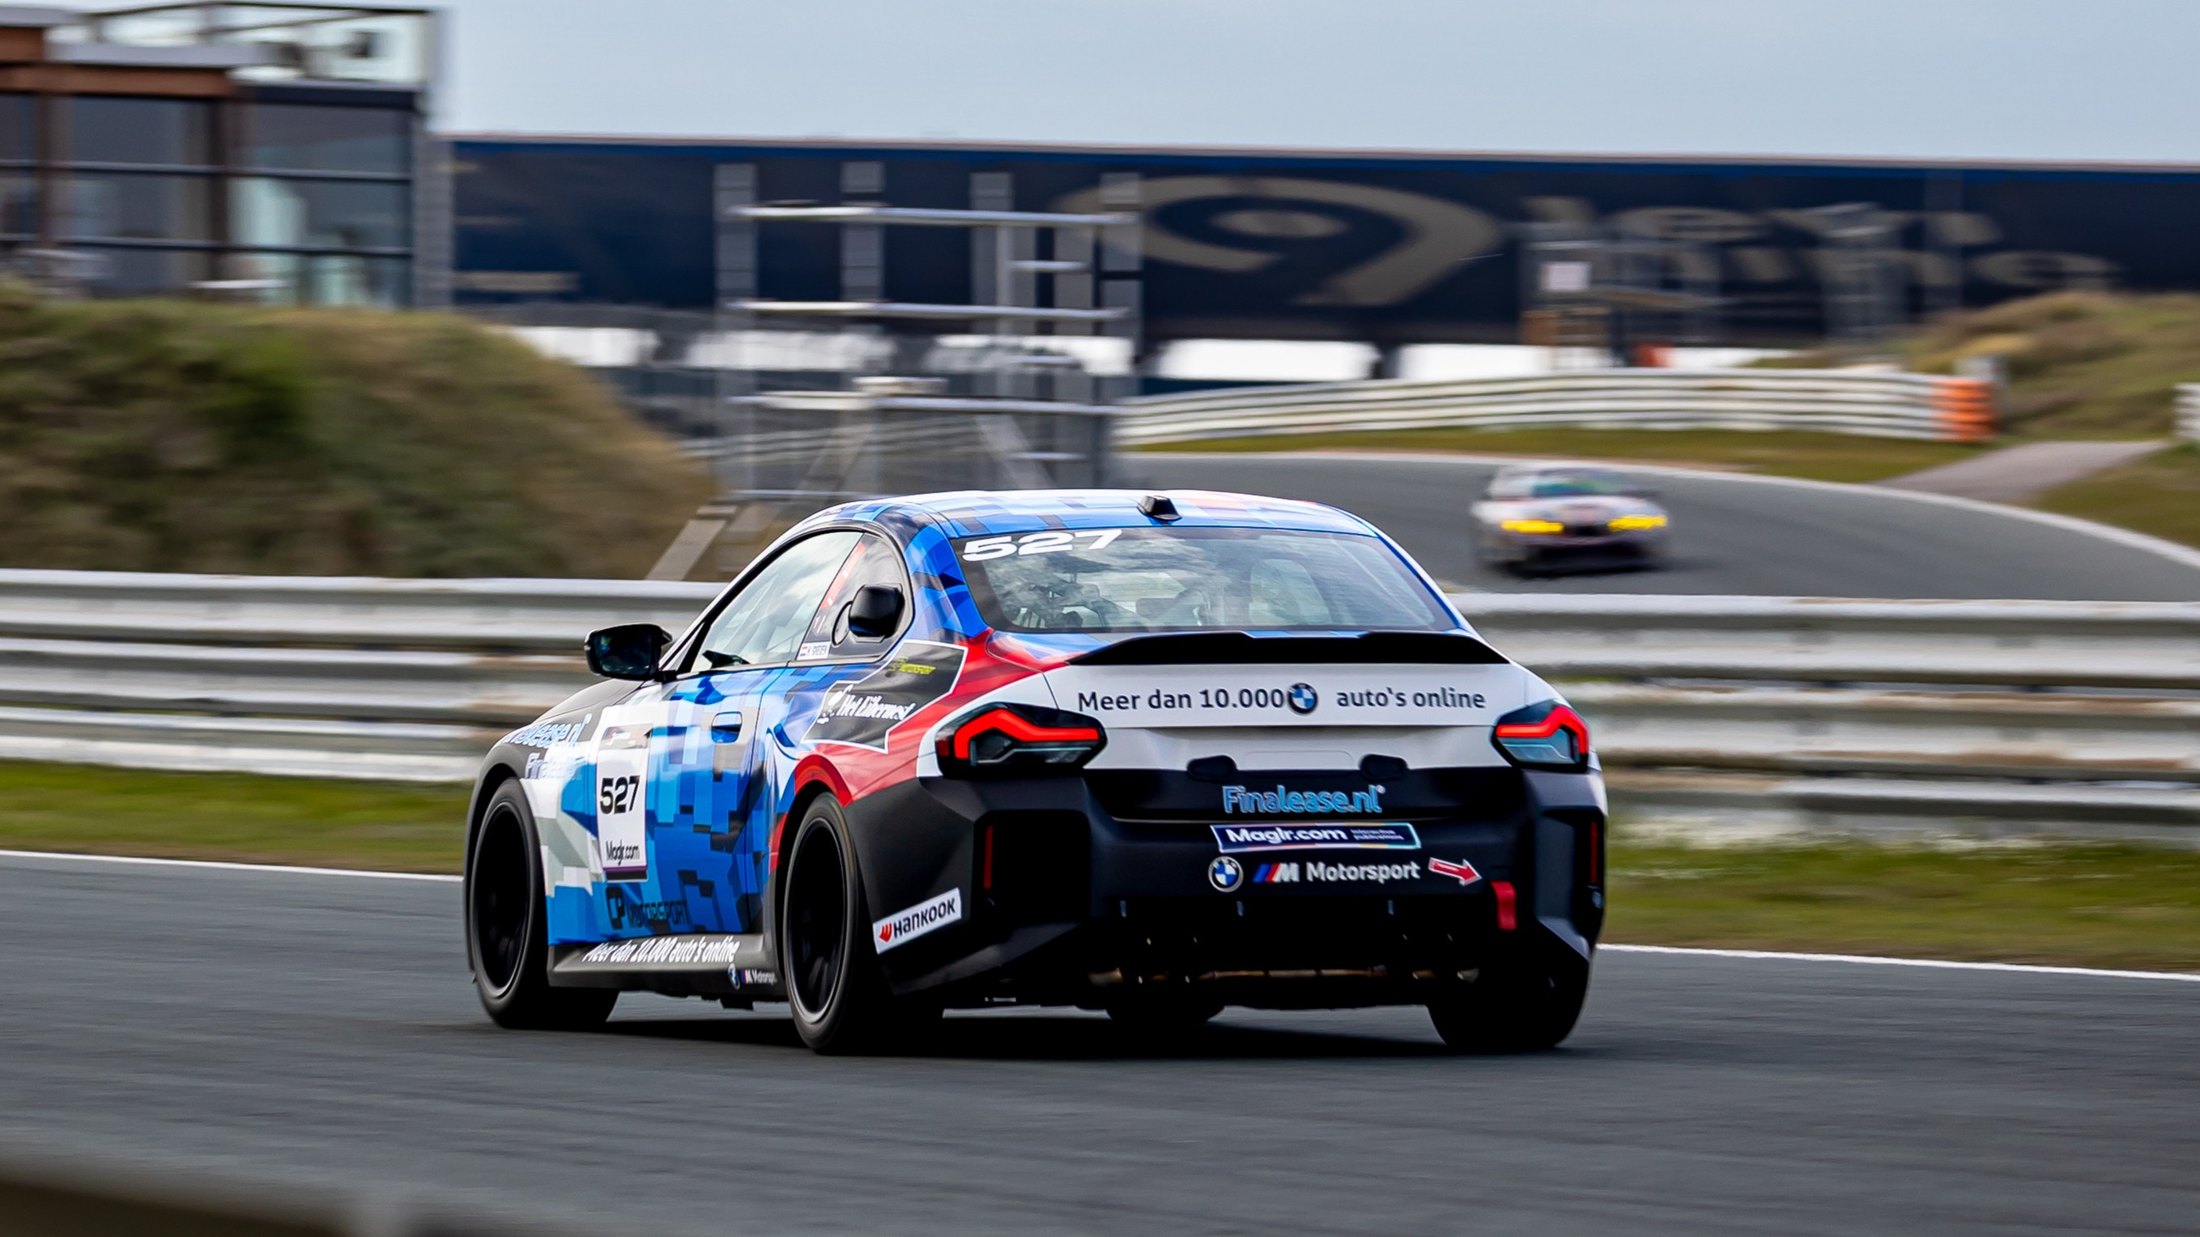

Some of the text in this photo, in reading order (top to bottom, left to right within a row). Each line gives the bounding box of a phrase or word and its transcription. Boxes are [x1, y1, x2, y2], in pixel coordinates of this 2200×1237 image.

[962, 529, 1122, 562] 527
[1077, 691, 1141, 712] Meer
[1147, 688, 1193, 709] dan
[1198, 688, 1285, 709] 10.000
[1336, 687, 1407, 707] auto's
[1412, 687, 1486, 709] online
[599, 775, 641, 815] 527
[1222, 784, 1383, 814] Finalease.nl
[1225, 827, 1349, 844] Maglr.com
[1306, 861, 1421, 884] Motorsport
[610, 940, 637, 963] dan
[630, 937, 678, 963] 10.000
[668, 936, 706, 963] auto's
[702, 936, 740, 963] online
